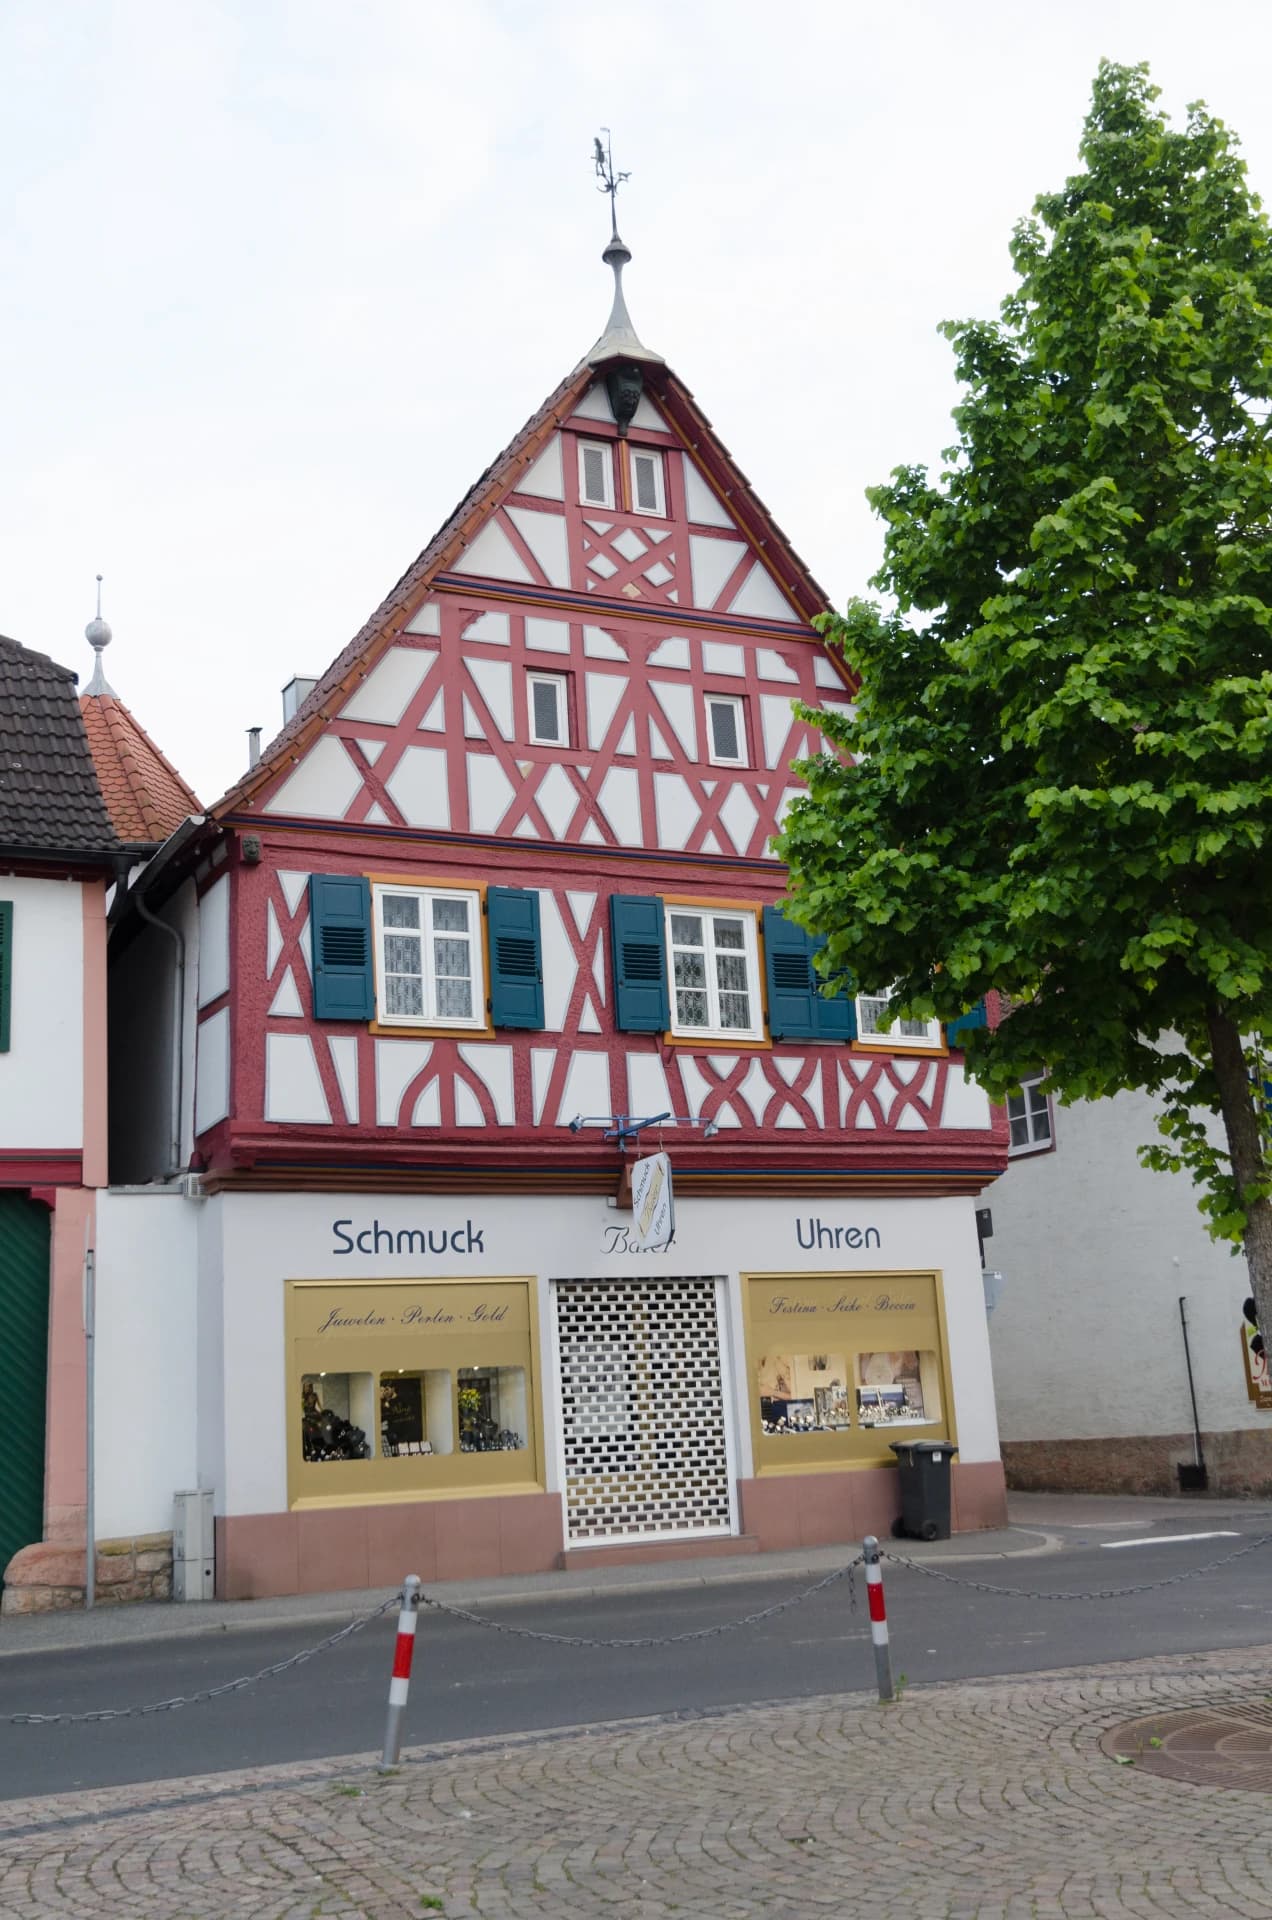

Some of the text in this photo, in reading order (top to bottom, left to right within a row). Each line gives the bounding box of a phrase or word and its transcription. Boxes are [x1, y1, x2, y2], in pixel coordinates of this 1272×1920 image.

[634, 1161, 650, 1208] Schmuck
[654, 1203, 667, 1235] Uhren
[796, 1218, 881, 1249] Uhren
[333, 1219, 485, 1255] Schmuck
[317, 1303, 510, 1333] Juwelen Perlen Gold
[769, 1294, 916, 1314] Festina Seiko Boccia
